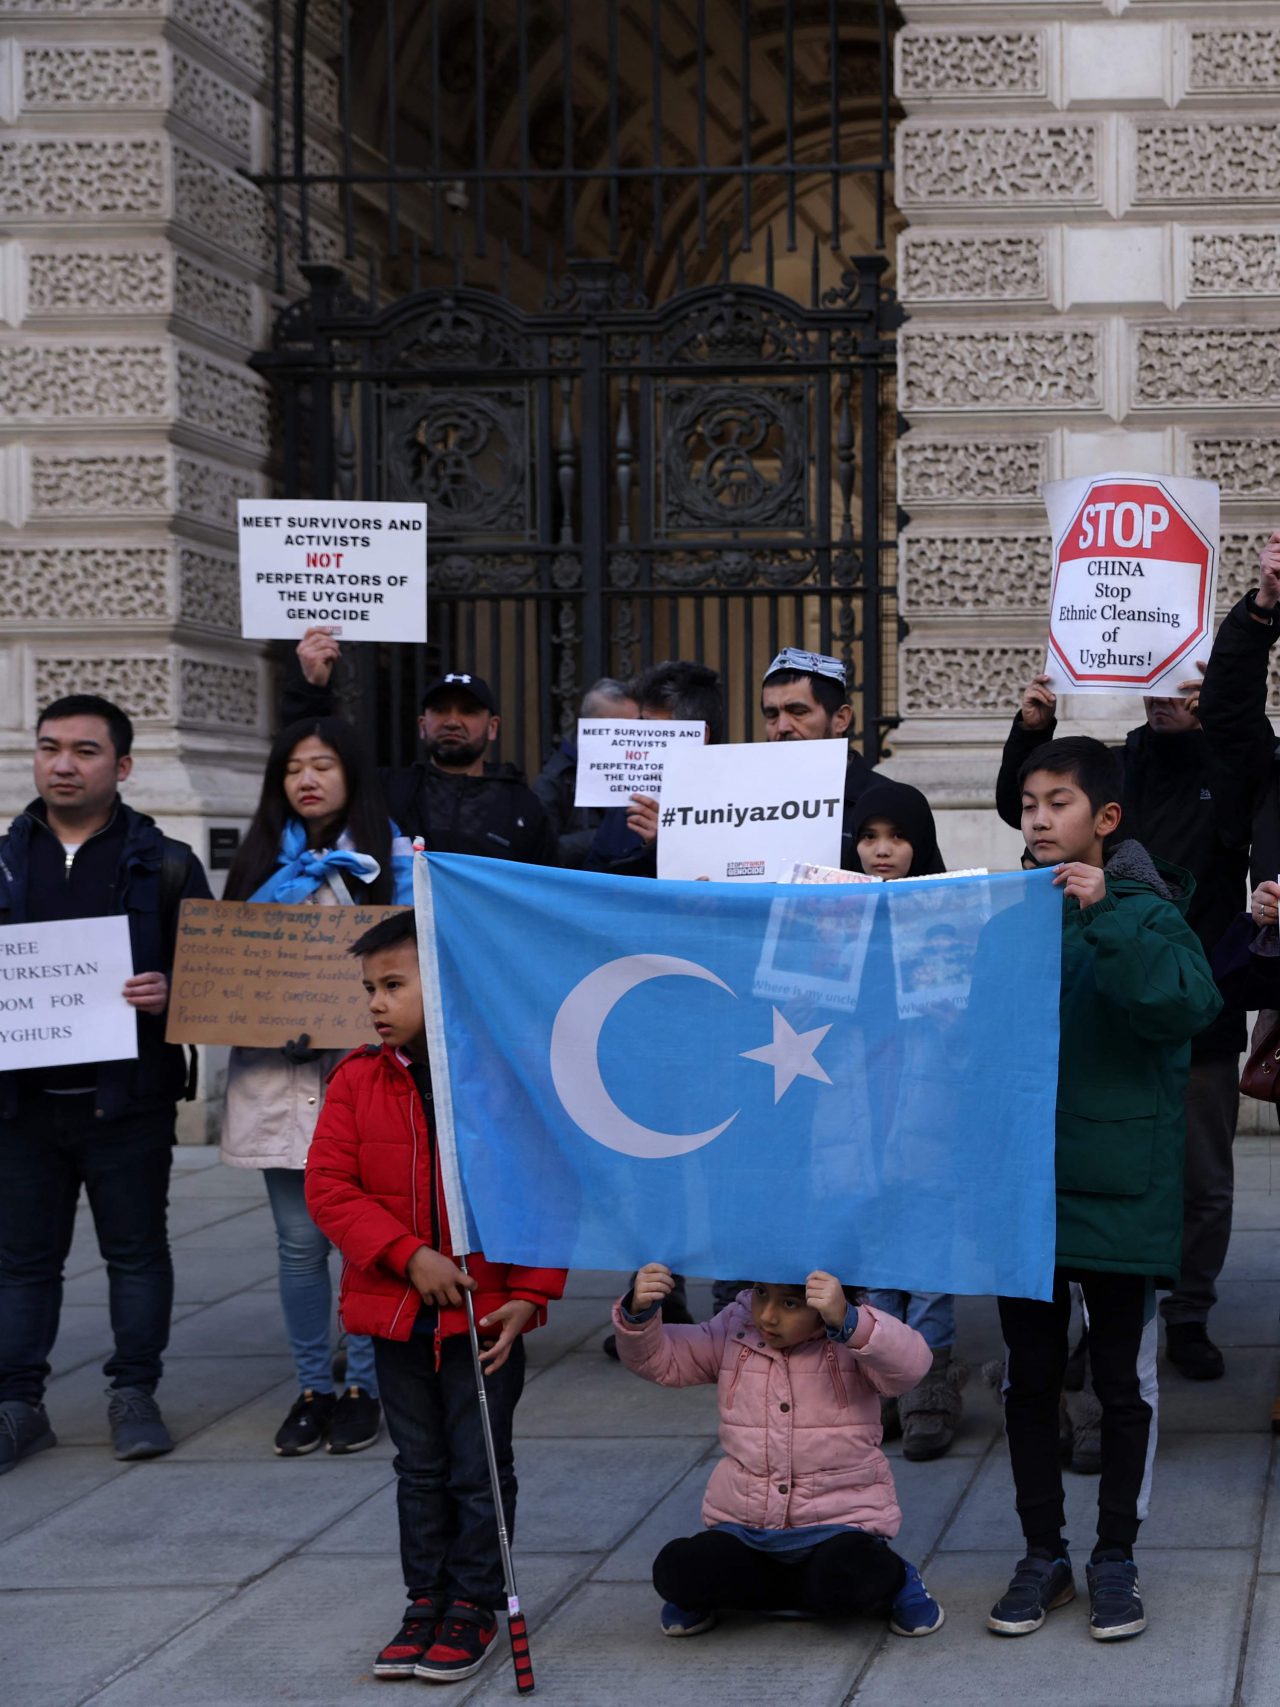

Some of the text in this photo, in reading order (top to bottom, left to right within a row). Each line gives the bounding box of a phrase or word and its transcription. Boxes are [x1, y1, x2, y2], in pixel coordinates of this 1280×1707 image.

[242, 517, 422, 531] MEET SURVIVORS AND
[1079, 502, 1170, 549] STOP
[285, 535, 370, 547] ACTIVISTS
[307, 553, 344, 568] NOT
[1088, 561, 1144, 576] CHINA
[257, 573, 408, 586] PERPETRATORS OF
[278, 591, 383, 603] THE UYGHUR
[1095, 583, 1131, 601] Stop
[287, 609, 369, 621] GENOCIDE
[1059, 605, 1180, 628] Ethnic Cleansing
[1102, 627, 1120, 642] of
[615, 729, 675, 737] SURVIVORS
[611, 740, 667, 748] ACTIVISTS
[625, 751, 649, 760] NOT
[661, 799, 840, 827] #TuniyazOUT
[329, 910, 346, 928] of
[354, 910, 373, 924] the
[0, 962, 98, 980] URKESTAN
[178, 981, 215, 999] CCP
[754, 979, 790, 994] Where
[806, 990, 824, 1001] my
[50, 993, 84, 1008] FOR
[229, 1007, 248, 1024] the
[333, 1015, 346, 1026] the
